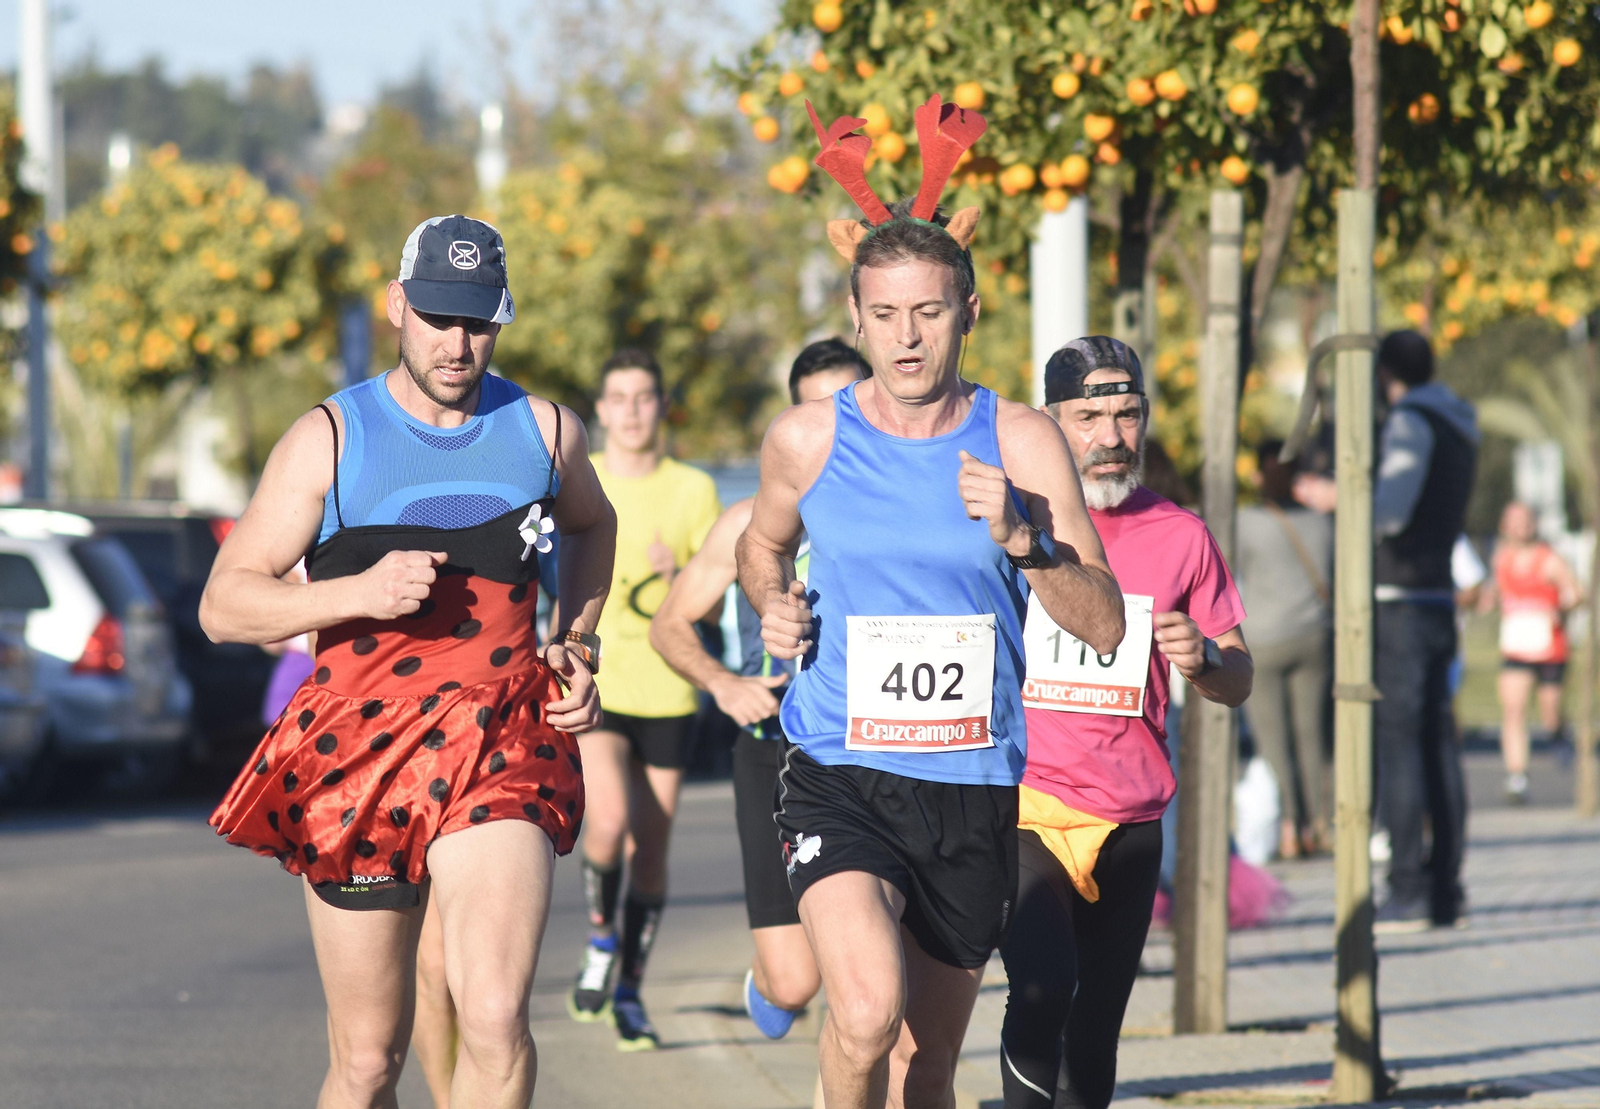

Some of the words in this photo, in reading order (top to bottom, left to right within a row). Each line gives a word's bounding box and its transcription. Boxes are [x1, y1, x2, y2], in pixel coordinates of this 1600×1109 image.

[881, 663, 963, 701] 402
[1023, 679, 1119, 707] Cruzcampo
[860, 719, 966, 745] Cruzcampo
[971, 722, 981, 739] SIN
